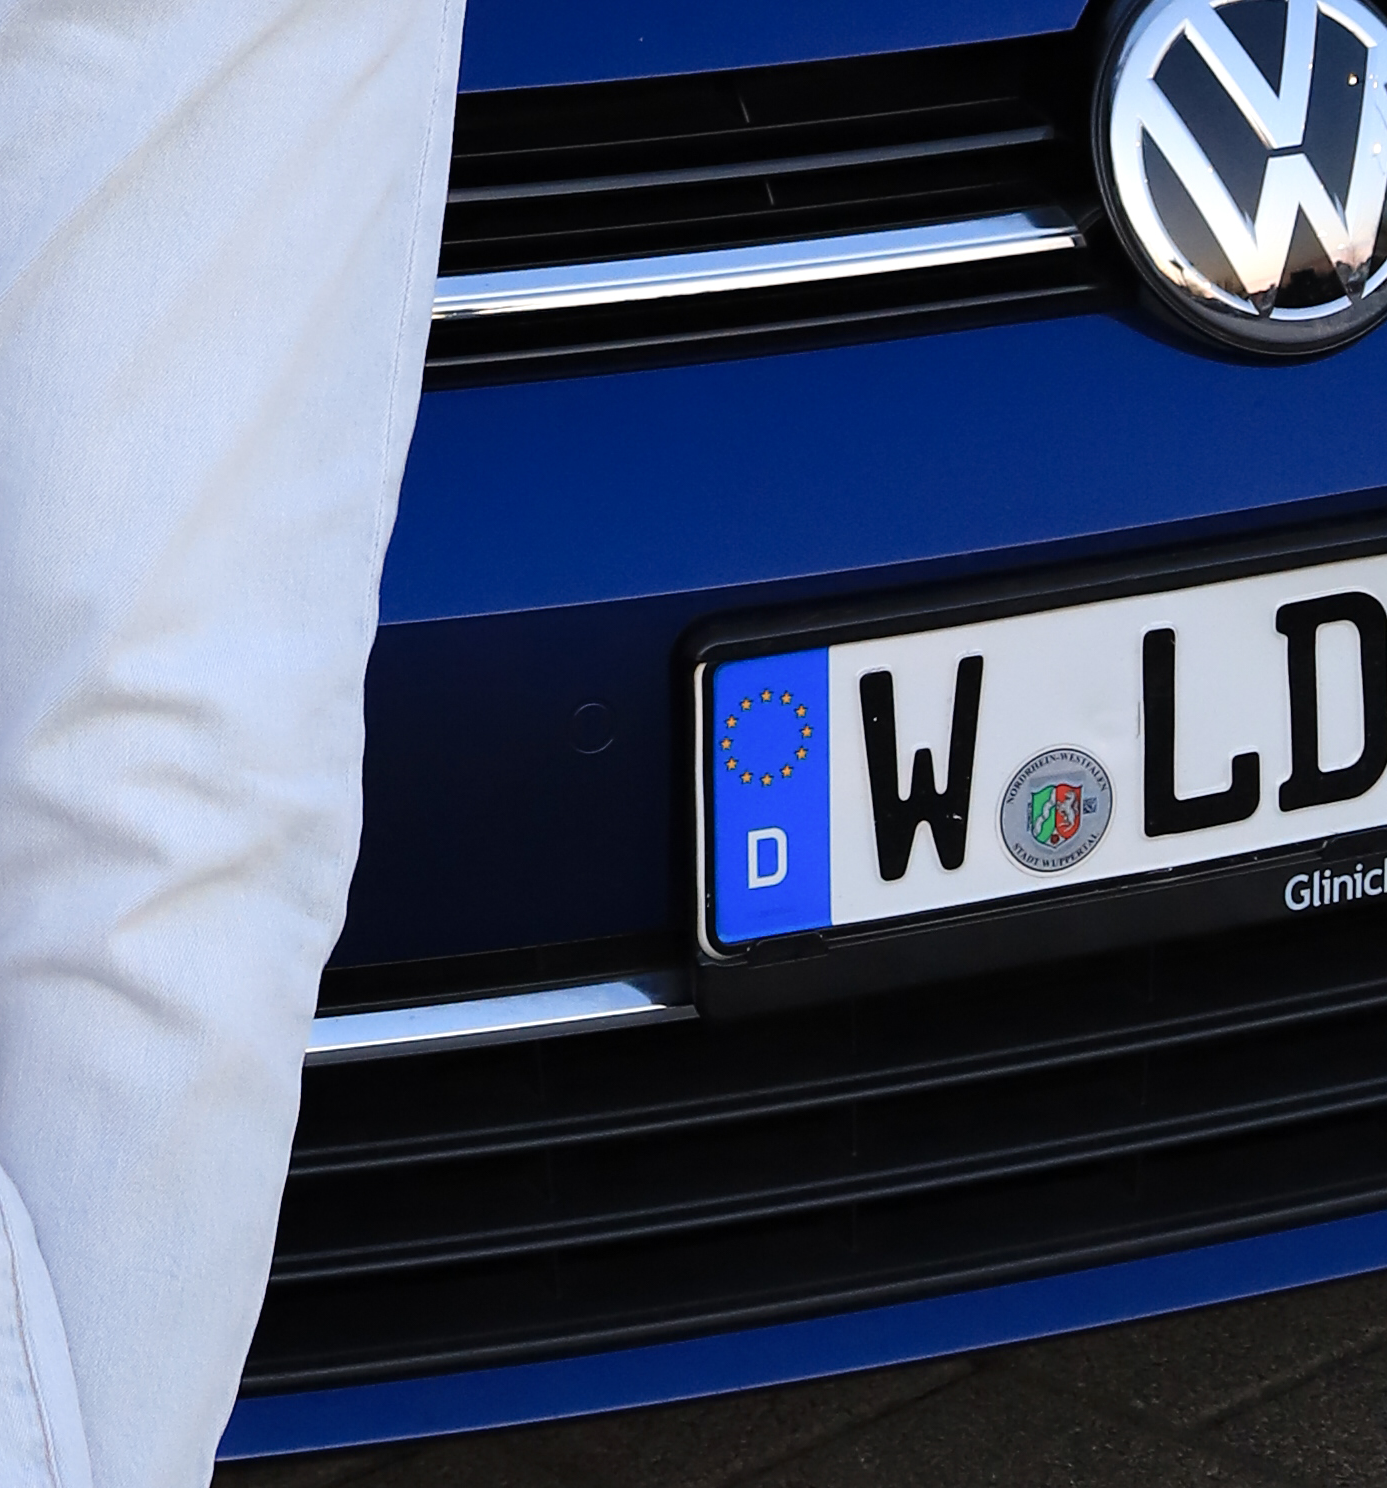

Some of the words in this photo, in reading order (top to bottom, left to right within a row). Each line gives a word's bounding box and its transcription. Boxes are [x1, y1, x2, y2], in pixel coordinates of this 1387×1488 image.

[859, 654, 985, 882] W
[1141, 590, 1387, 839] LD
[746, 829, 789, 889] D
[1012, 842, 1039, 867] STADT
[1042, 831, 1100, 867] WUPPERTAL
